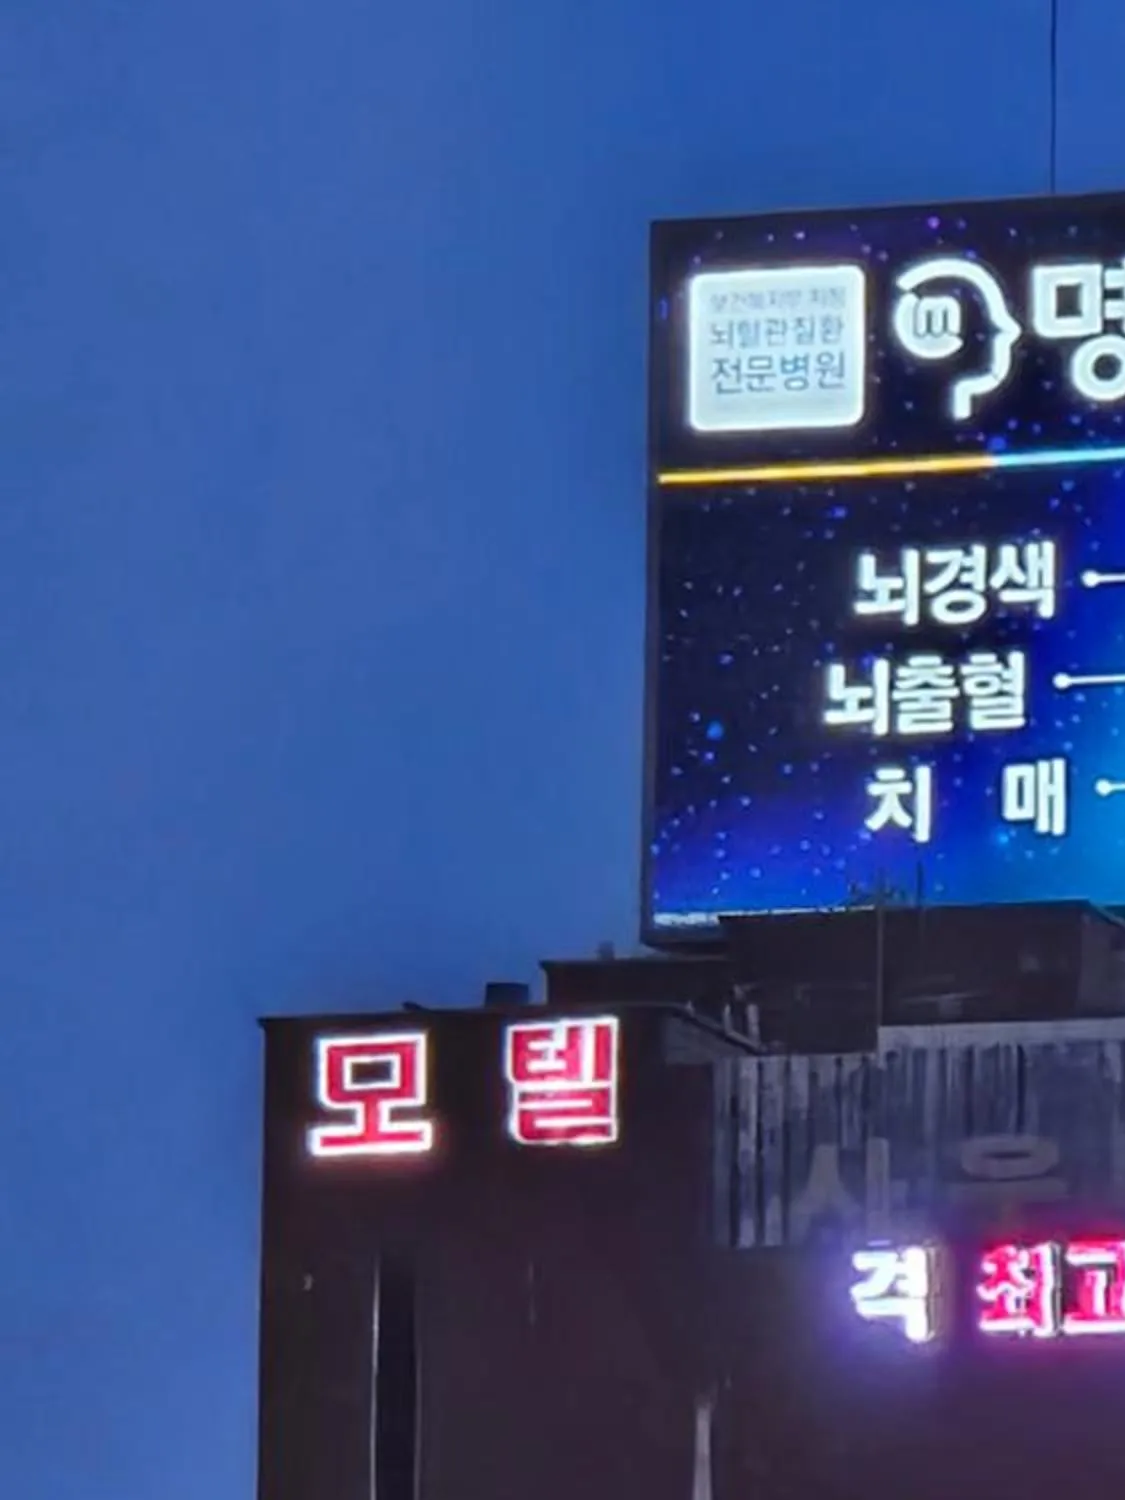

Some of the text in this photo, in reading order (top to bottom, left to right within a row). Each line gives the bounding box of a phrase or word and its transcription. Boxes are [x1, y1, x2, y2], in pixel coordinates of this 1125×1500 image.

[711, 313, 846, 350] 뇌혈관질환
[711, 350, 847, 395] 전문병원
[854, 540, 1056, 627] 뇌경색
[823, 650, 1027, 736] 뇌출혈
